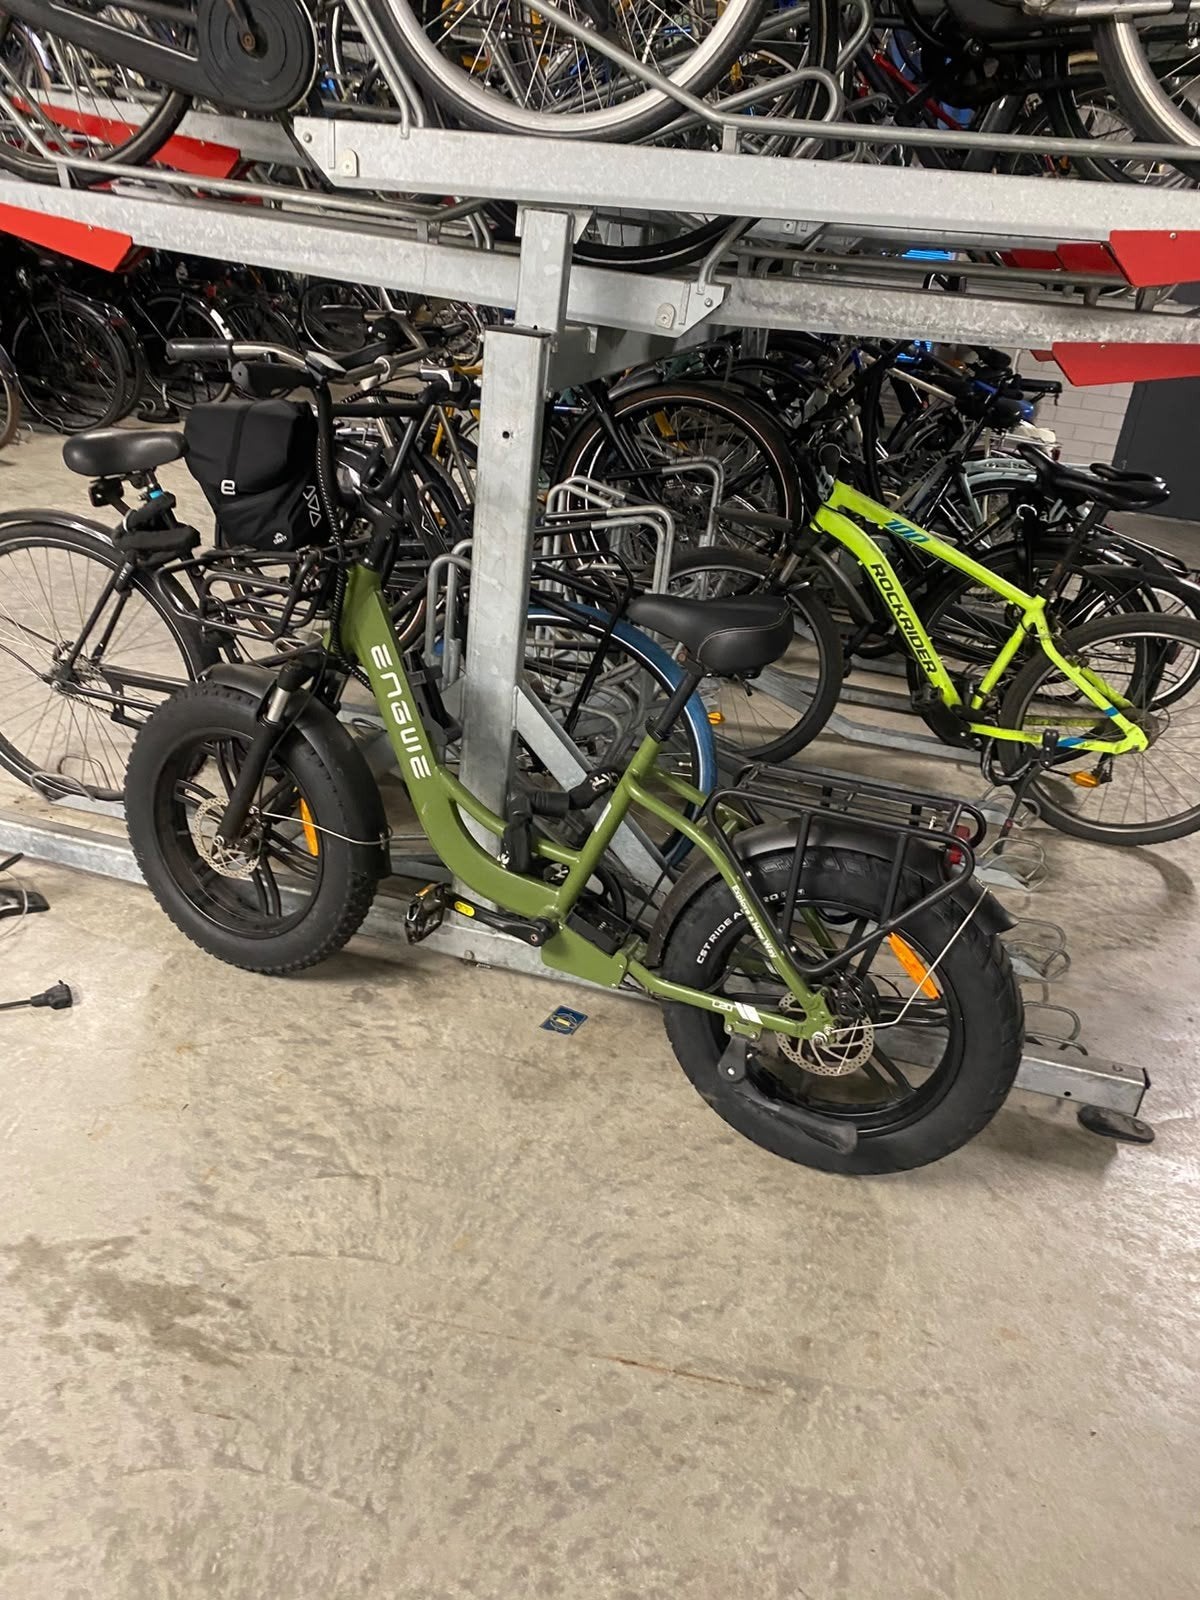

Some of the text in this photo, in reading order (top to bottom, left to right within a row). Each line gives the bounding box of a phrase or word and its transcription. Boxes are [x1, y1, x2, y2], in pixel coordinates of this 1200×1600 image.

[870, 563, 938, 674] ROCKRIDER
[696, 942, 711, 964] CST
[709, 917, 733, 943] RIDE
[732, 884, 751, 915] Explore
[752, 922, 766, 940] New
[763, 939, 777, 958] Way
